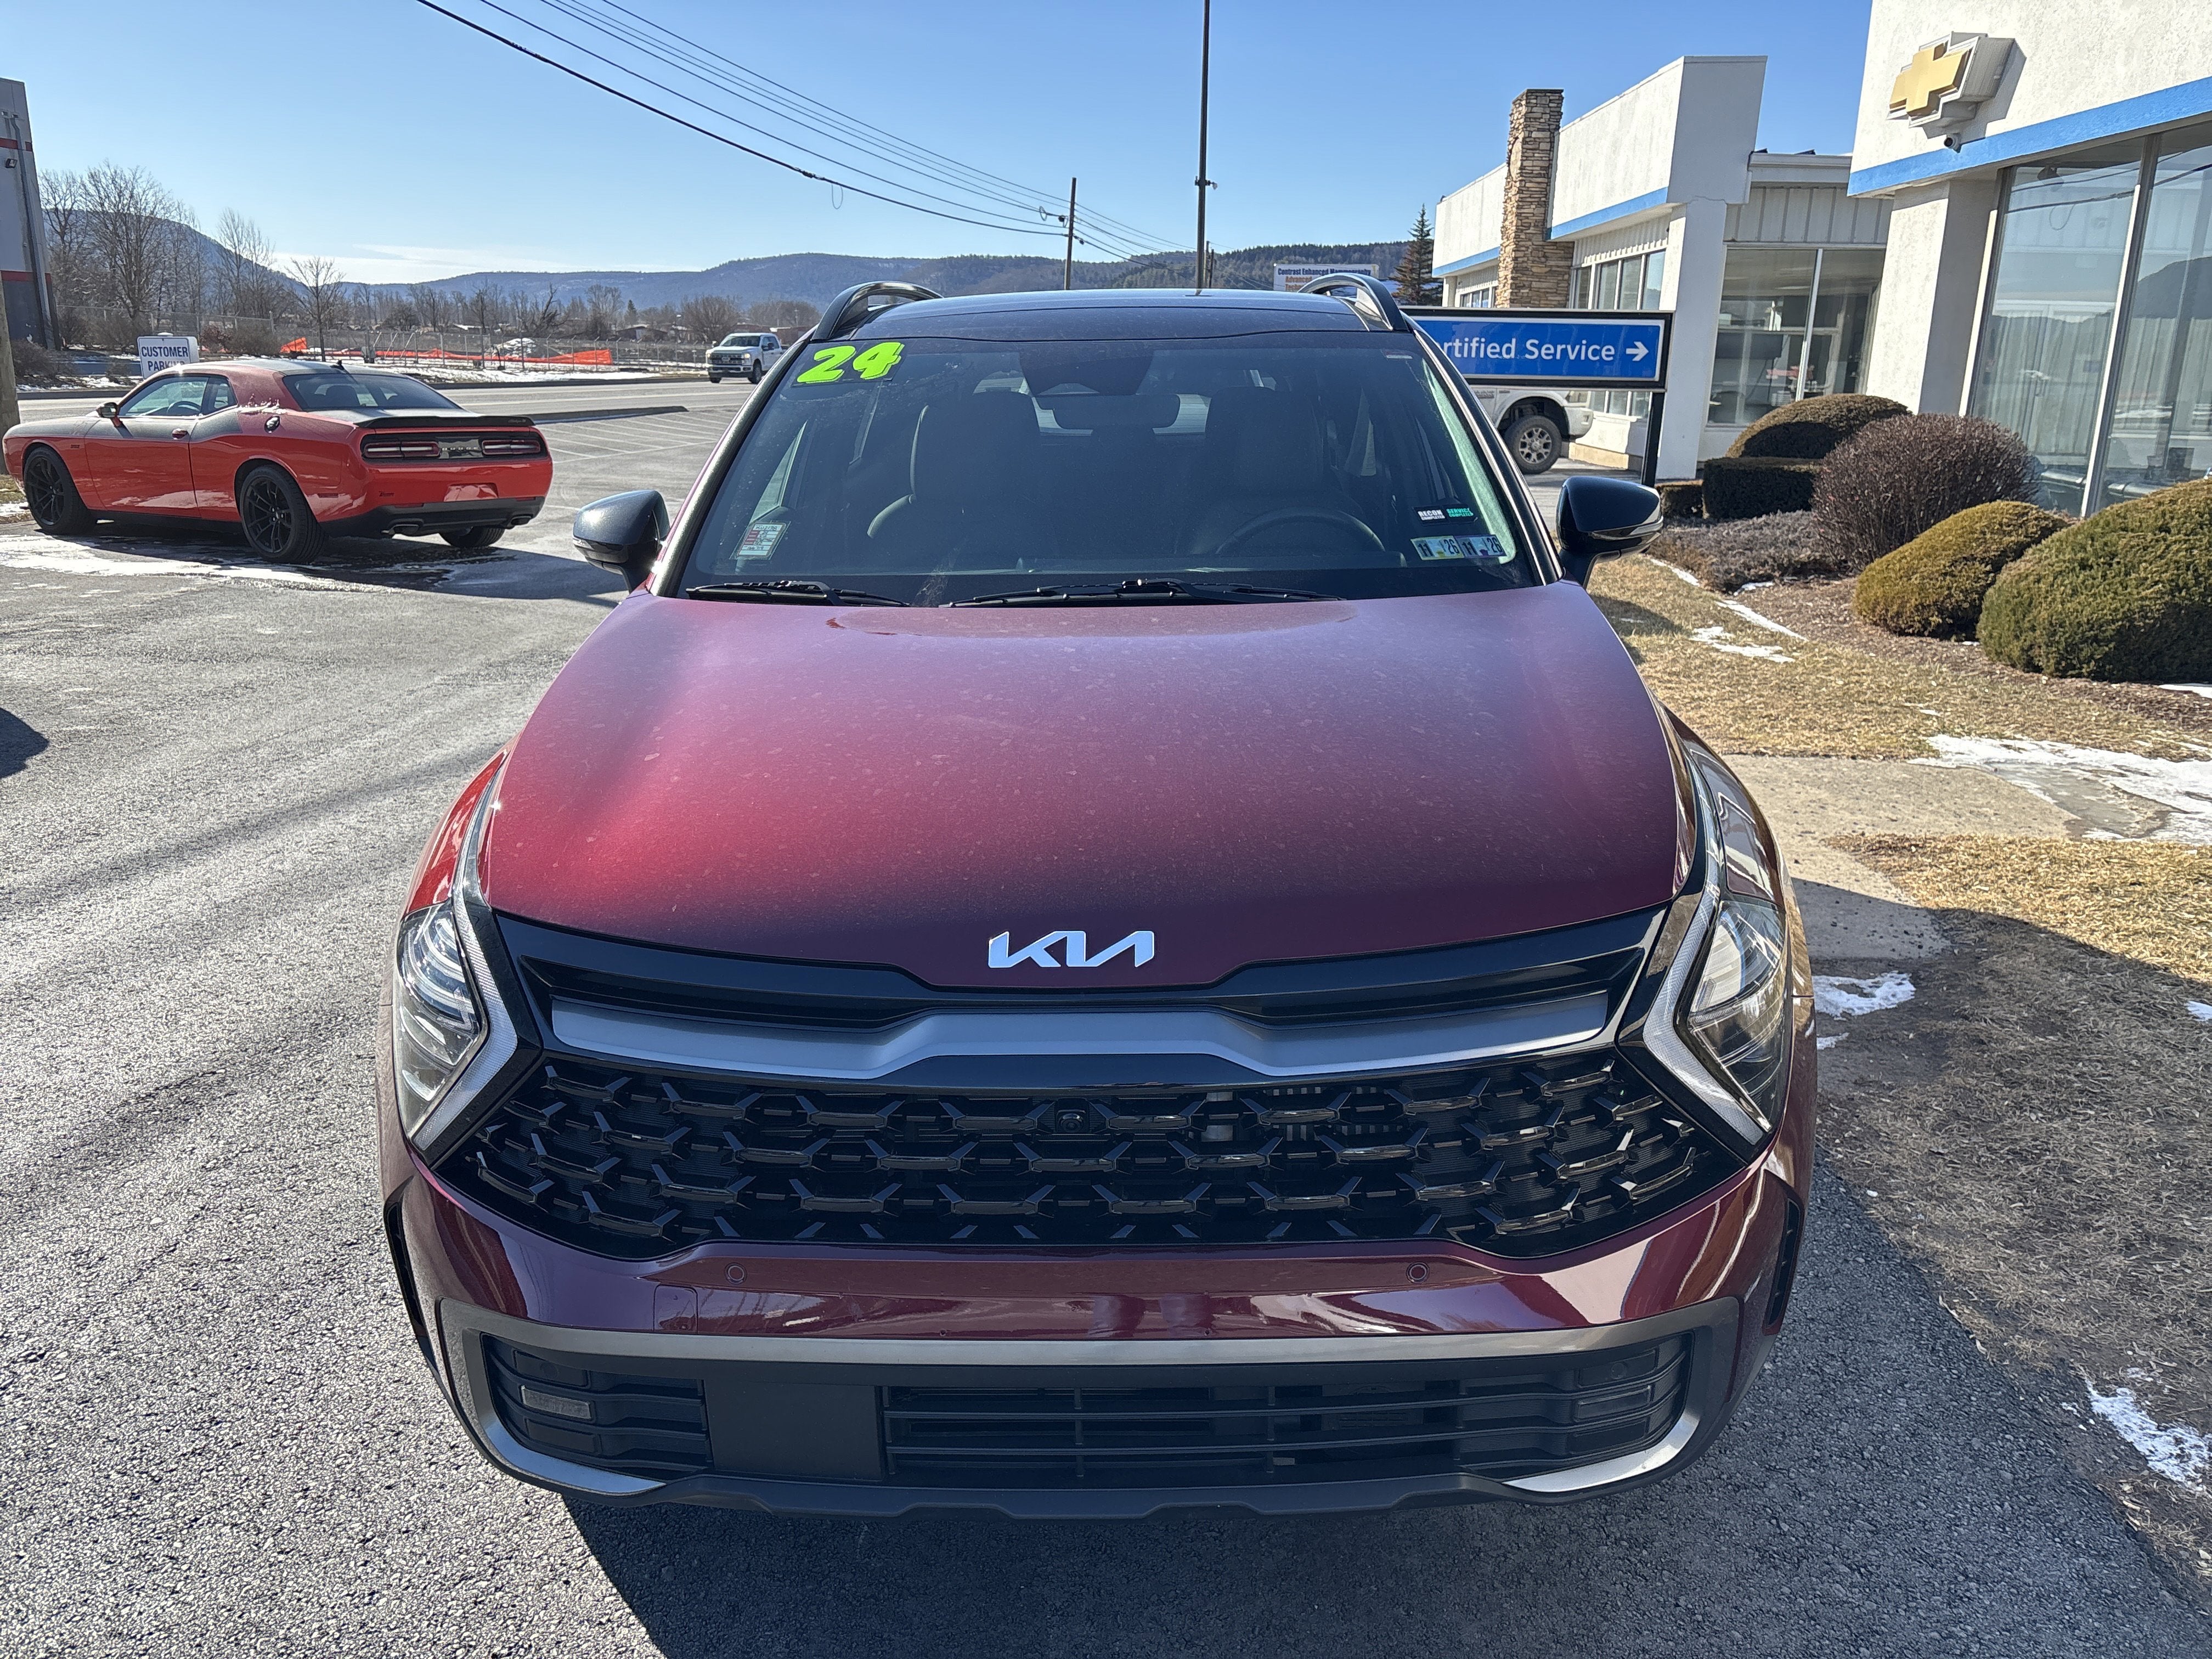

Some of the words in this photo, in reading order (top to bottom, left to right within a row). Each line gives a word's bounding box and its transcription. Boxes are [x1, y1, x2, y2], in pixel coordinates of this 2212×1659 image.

[141, 346, 189, 357] CUSTOMER
[1438, 337, 1516, 360] rtified
[1525, 339, 1615, 362] Service
[797, 342, 905, 383] 24
[1418, 543, 1434, 557] 11
[1443, 539, 1460, 555] 26
[1462, 541, 1477, 555] 11
[1486, 537, 1503, 553] 26
[988, 930, 1154, 968] KIA
